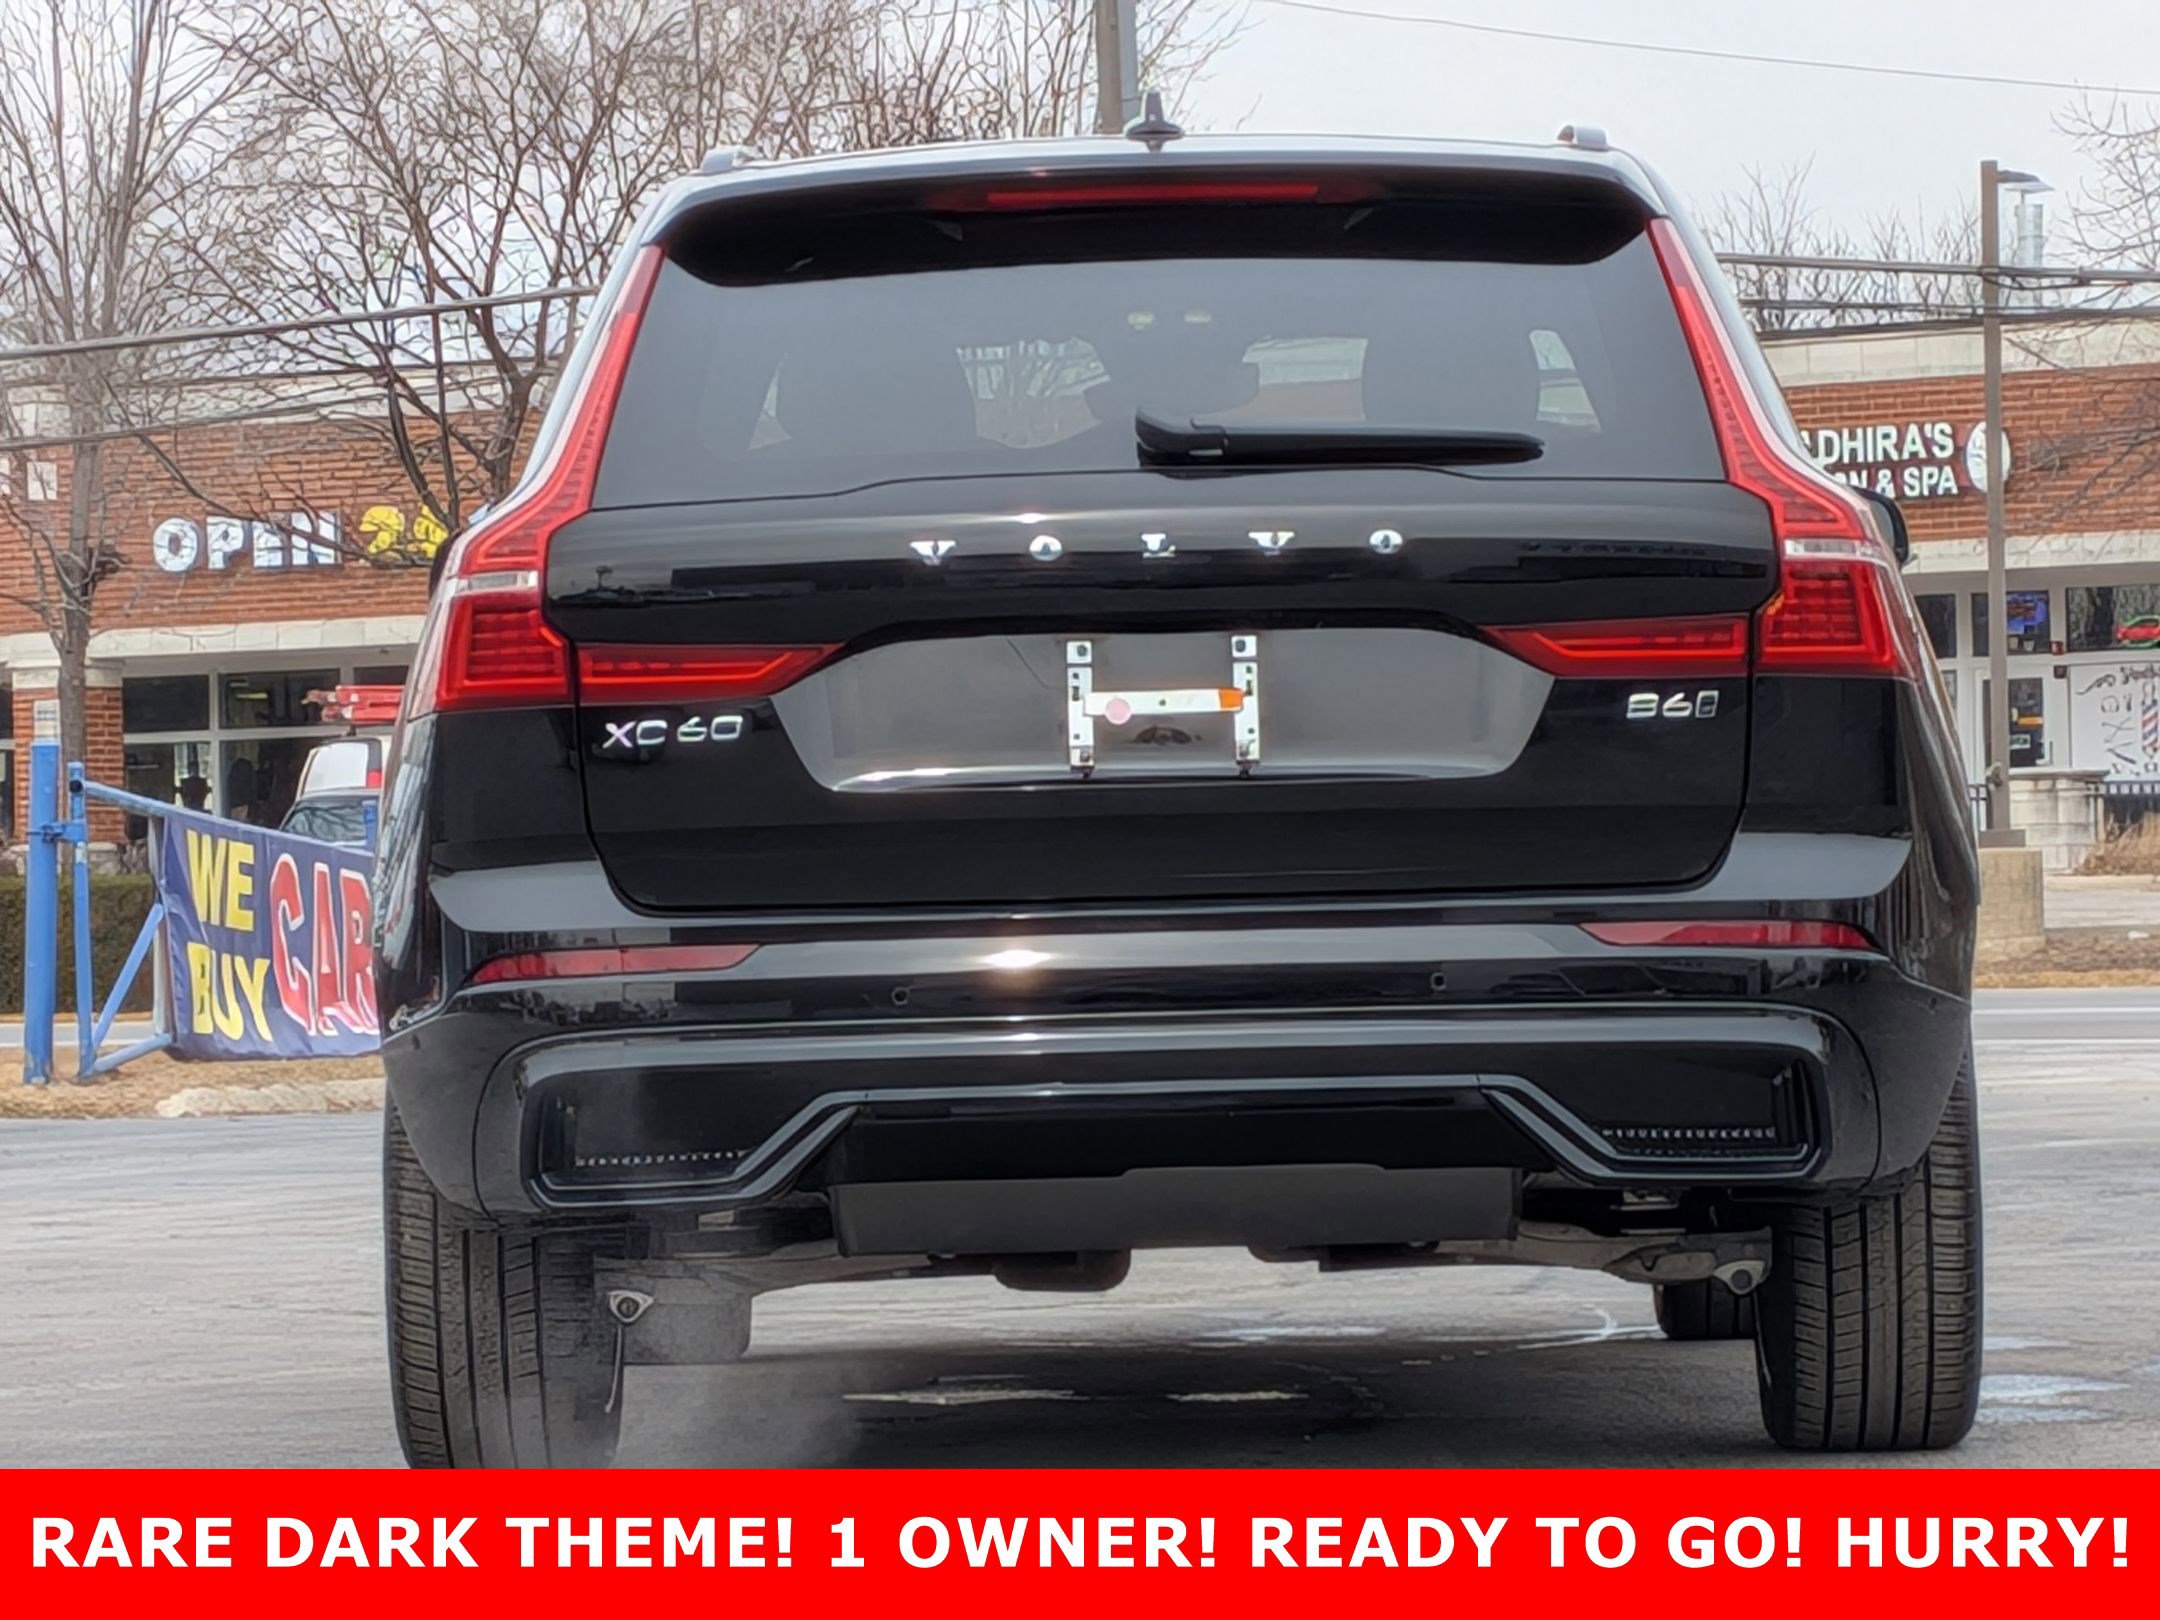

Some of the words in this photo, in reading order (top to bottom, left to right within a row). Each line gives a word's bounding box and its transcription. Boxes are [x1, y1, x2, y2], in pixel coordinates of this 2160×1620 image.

[1801, 422, 1954, 465] DHIRA'S
[1875, 468, 1895, 499] &
[1903, 465, 1958, 497] SPA
[153, 511, 337, 572] OPEN
[910, 529, 1403, 566] VOLVO
[187, 829, 255, 931] WE
[187, 942, 273, 1042] BUY
